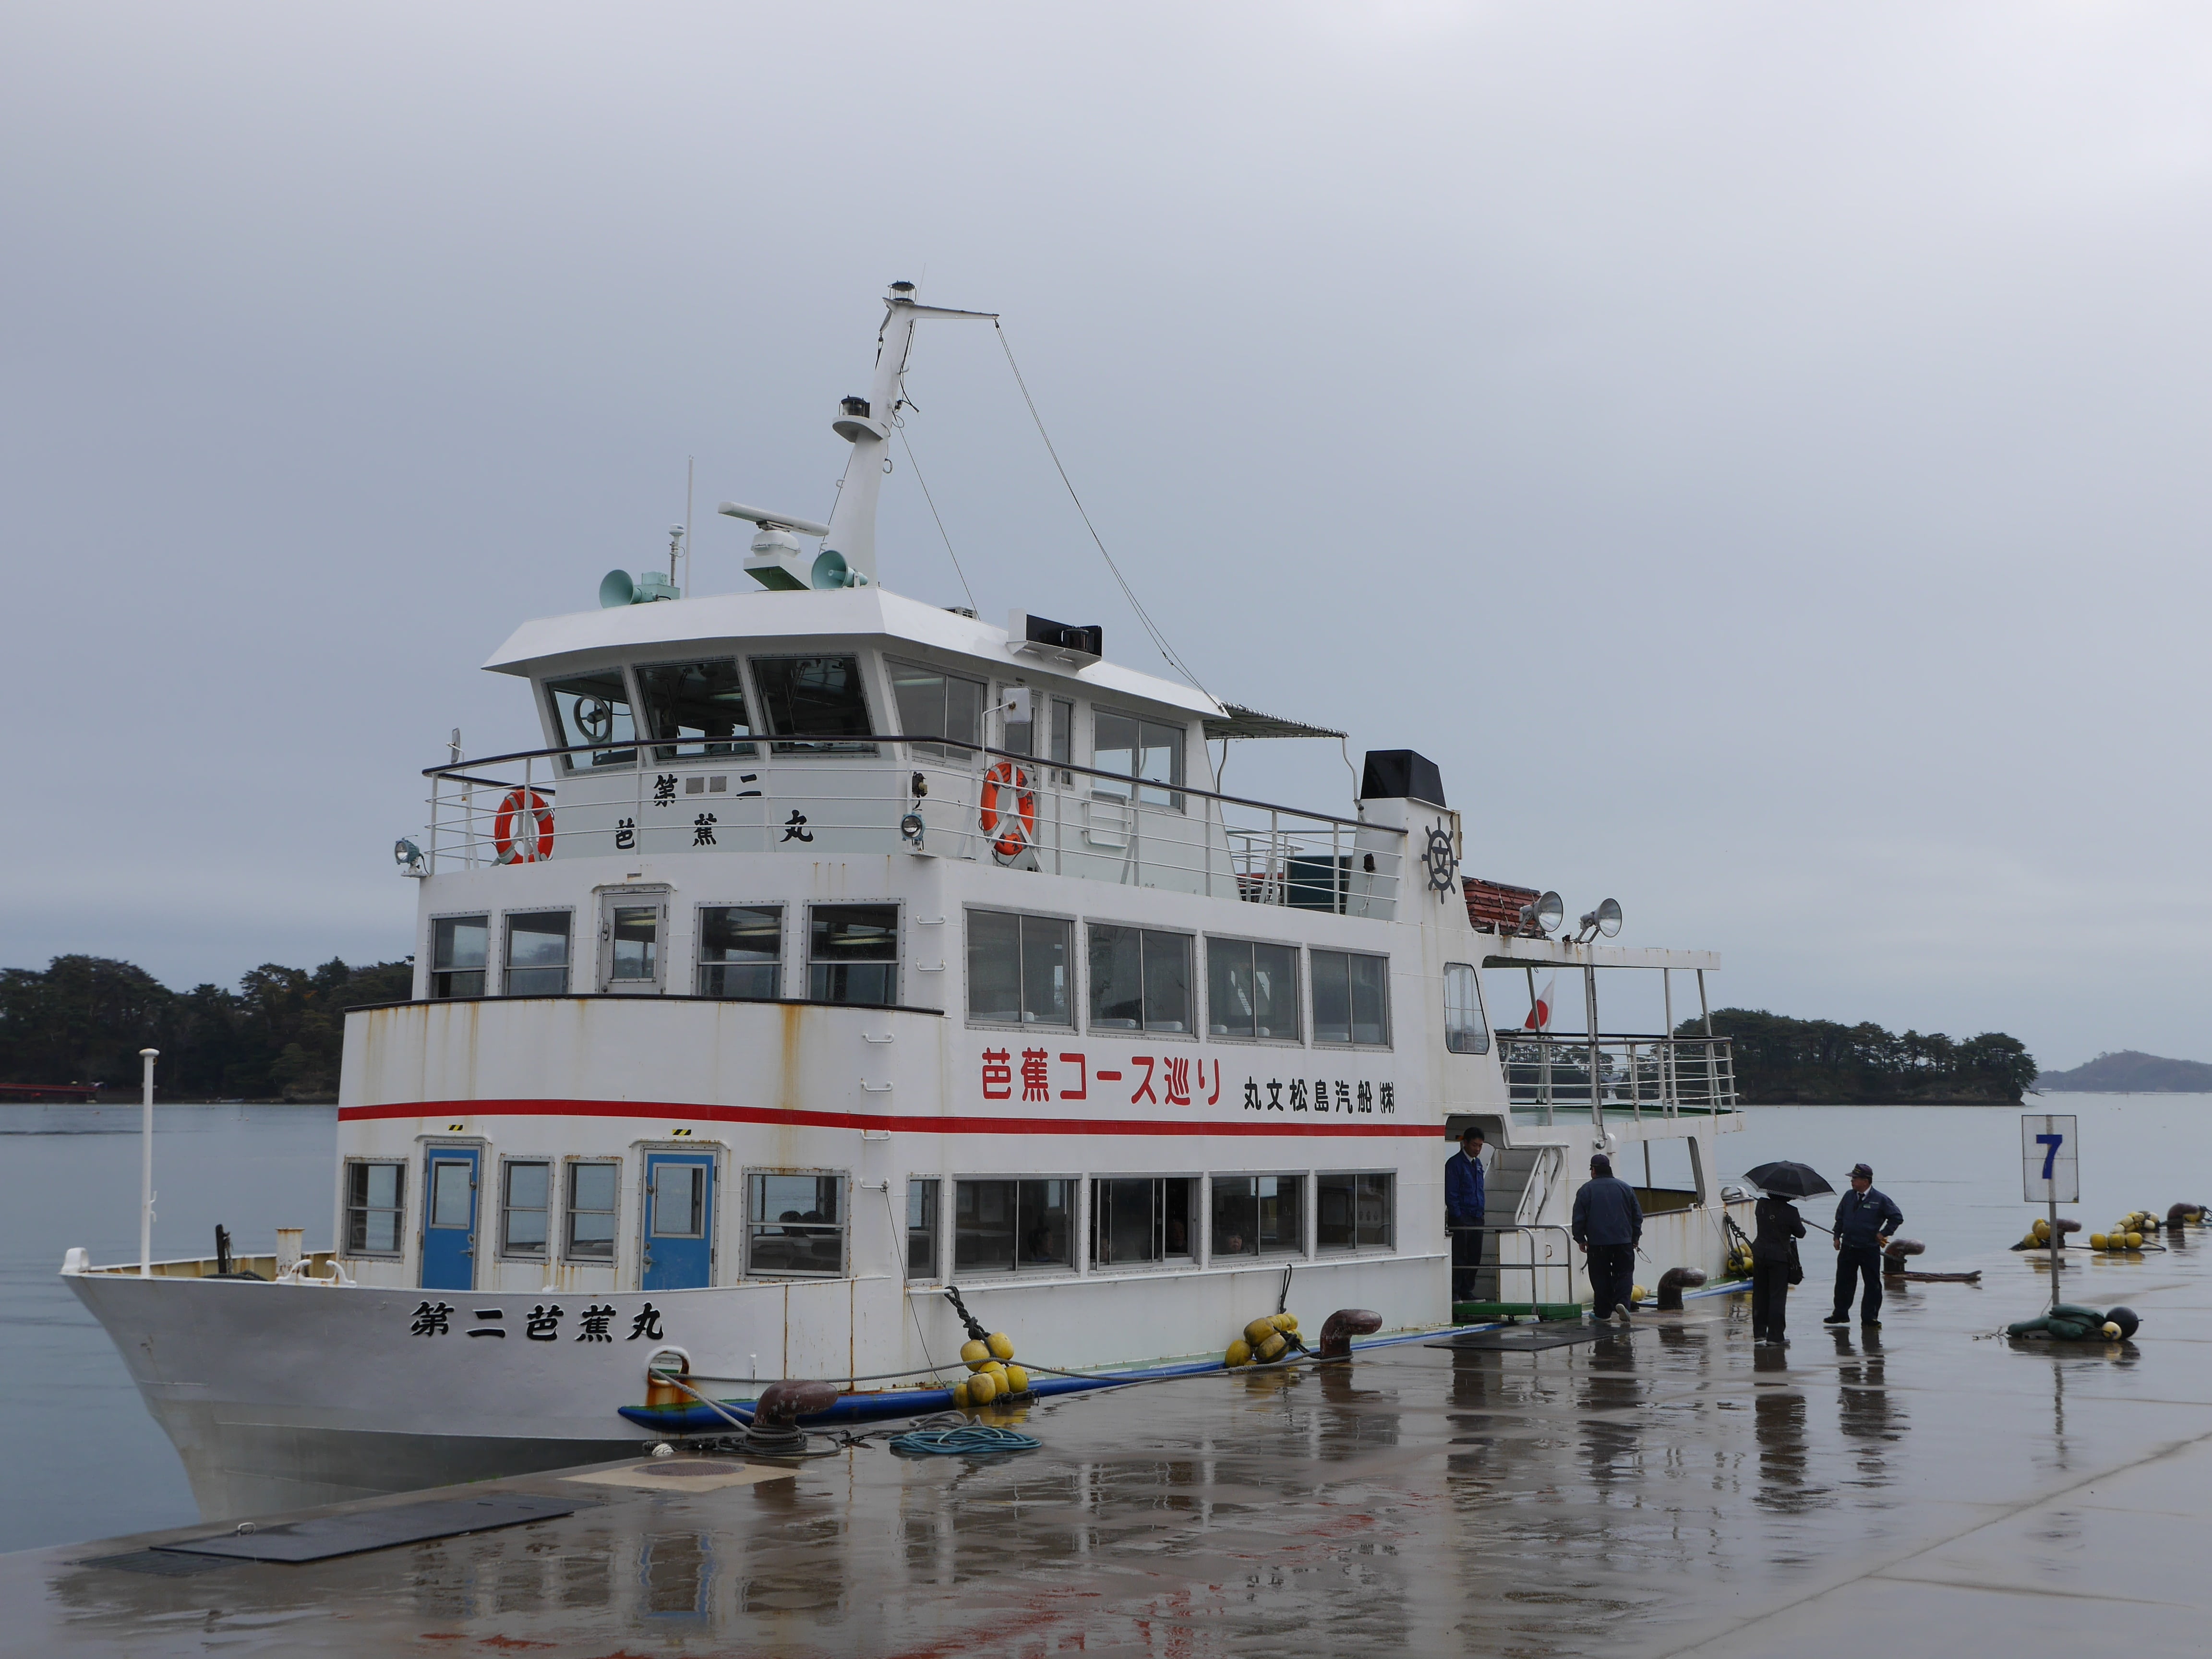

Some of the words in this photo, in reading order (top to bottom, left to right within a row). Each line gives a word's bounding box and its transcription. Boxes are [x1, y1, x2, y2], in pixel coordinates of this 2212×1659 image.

[653, 773, 762, 808] 第二
[614, 809, 814, 851] 芭蕉丸
[982, 1047, 1221, 1106] 芭蕉コース巡り
[2036, 1134, 2062, 1179] 7
[409, 1300, 664, 1343] 第二芭蕉丸
